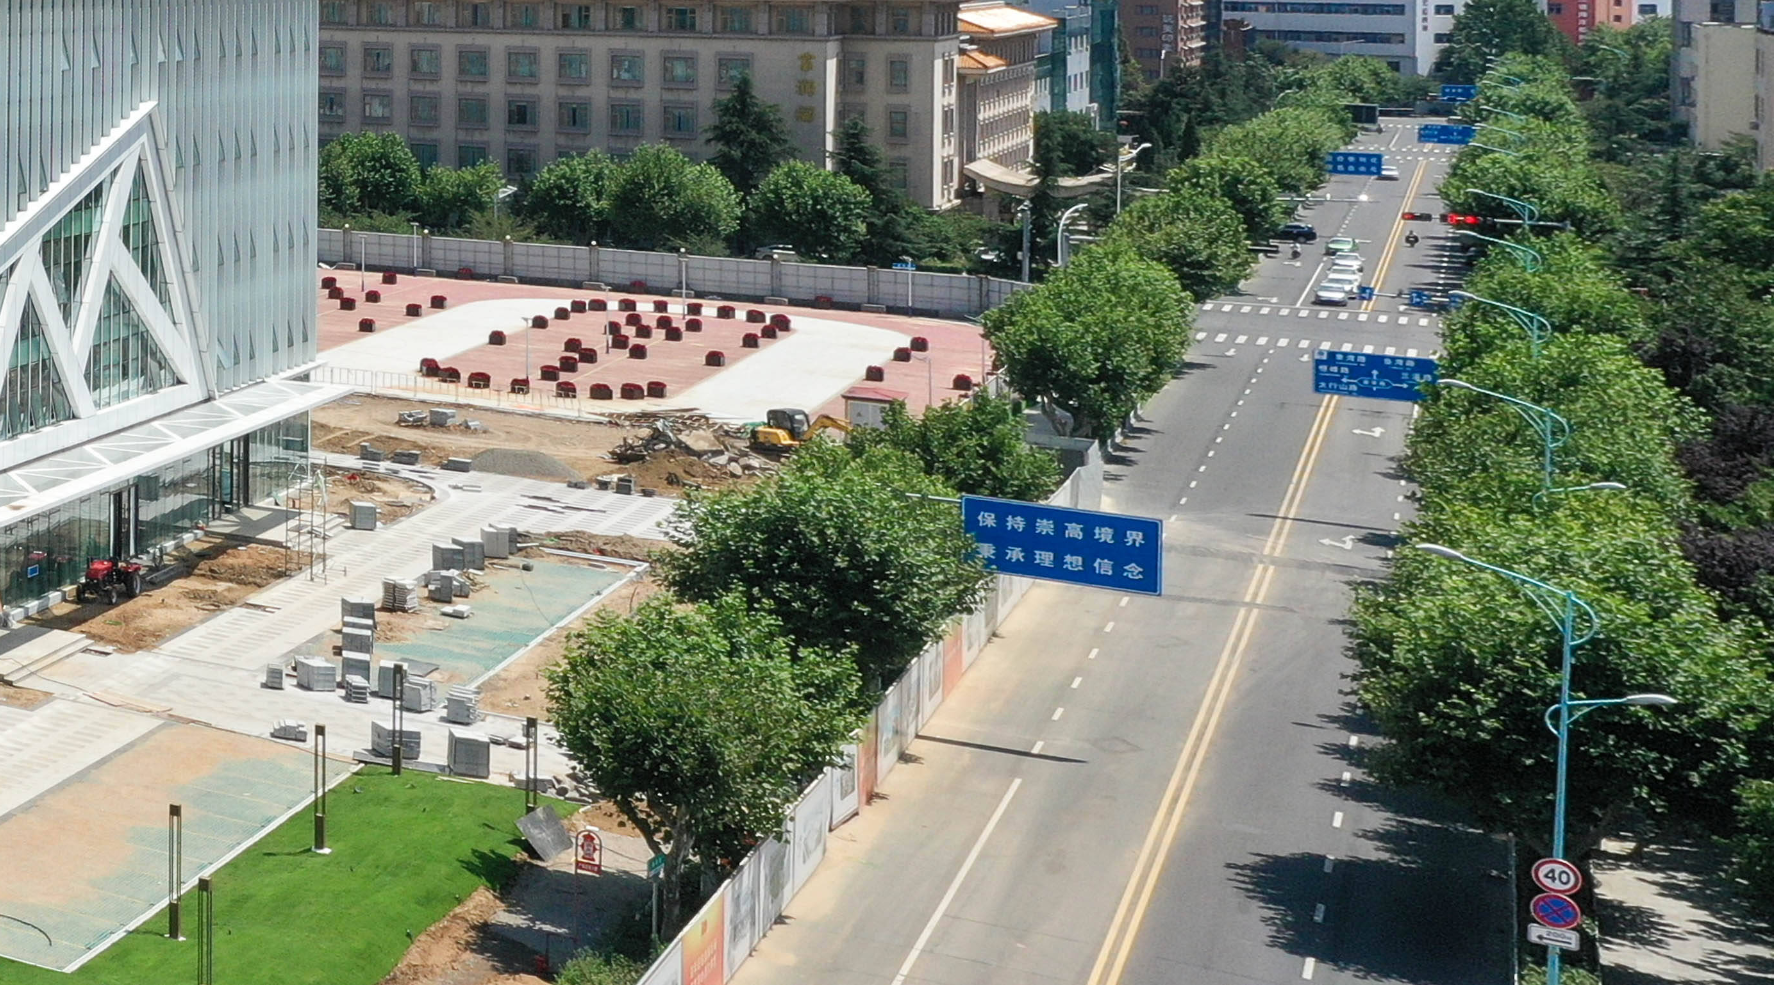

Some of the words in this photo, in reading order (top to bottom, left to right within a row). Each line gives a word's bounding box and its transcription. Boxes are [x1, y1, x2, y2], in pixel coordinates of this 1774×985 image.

[977, 510, 1145, 548] 保持崇高境界
[976, 542, 1145, 580] 秉承理想信念
[1544, 868, 1571, 885] 40
